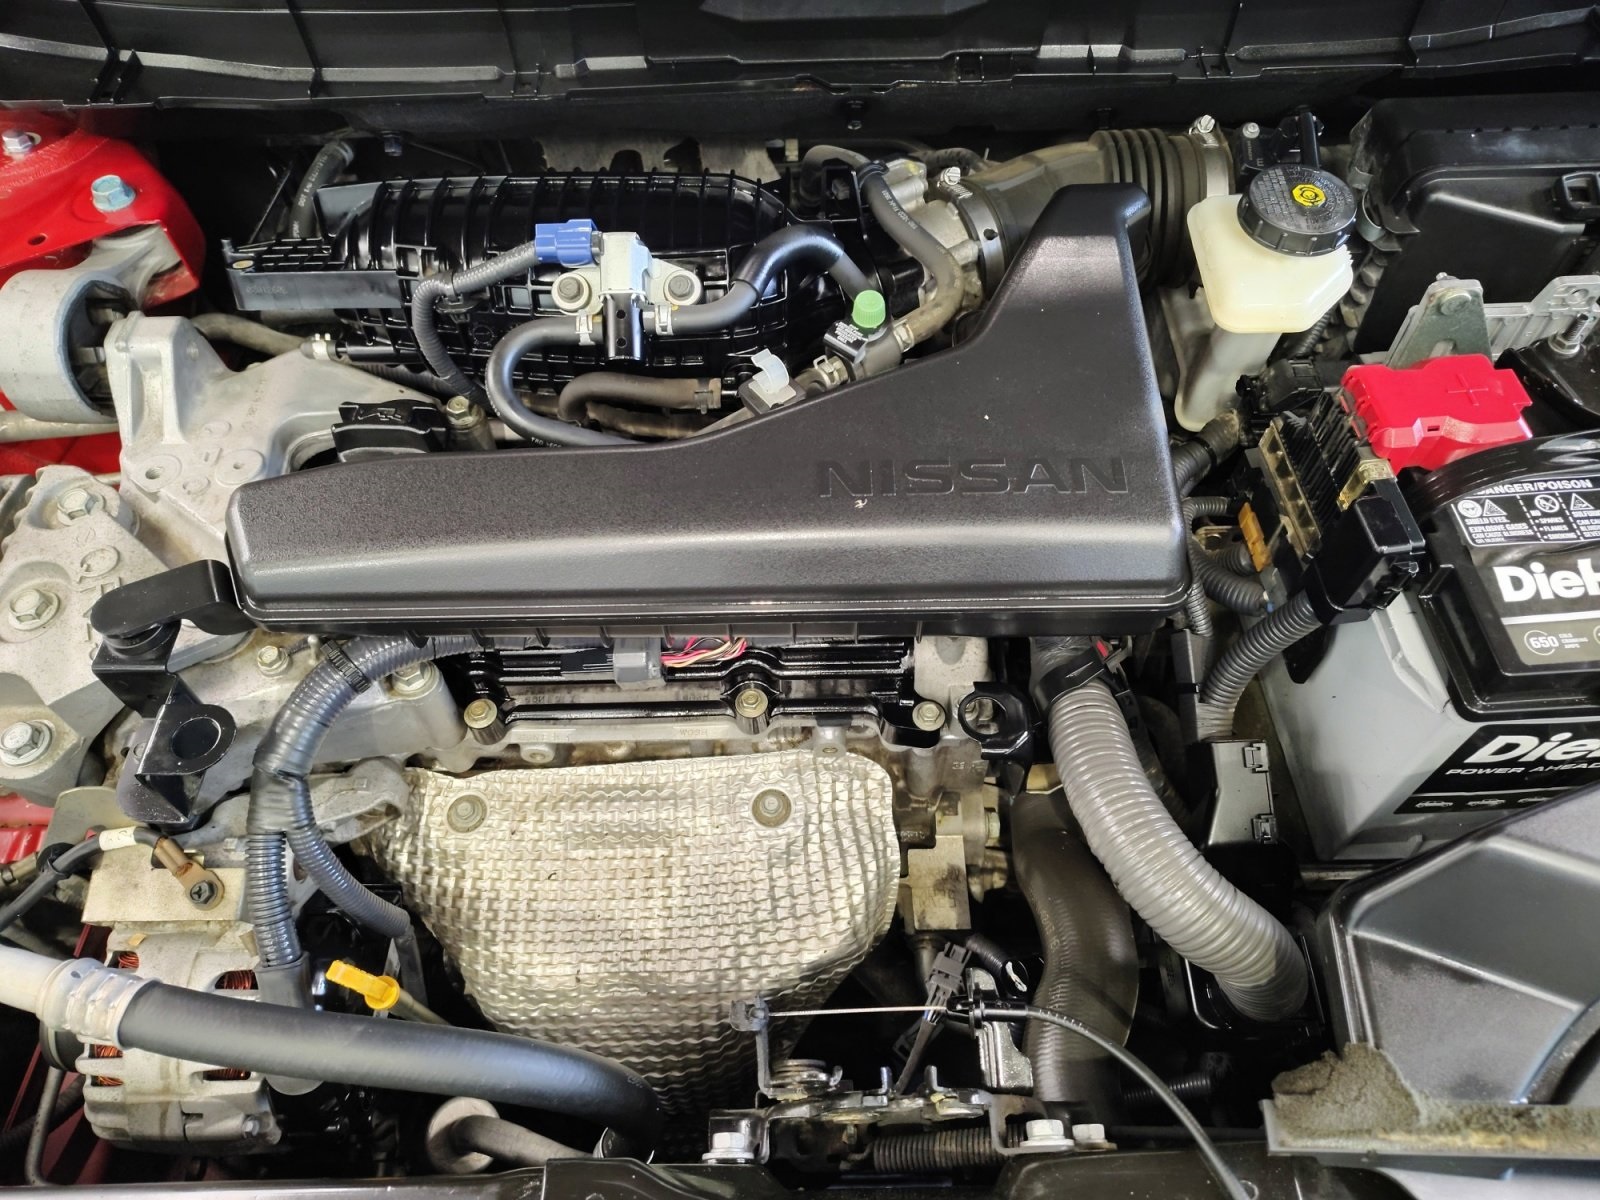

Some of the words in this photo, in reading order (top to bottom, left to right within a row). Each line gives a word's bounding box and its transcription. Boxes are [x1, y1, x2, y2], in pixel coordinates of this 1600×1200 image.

[817, 457, 1129, 498] NISSAN
[1529, 635, 1559, 649] 650
[1463, 732, 1600, 764] Die
[1445, 767, 1526, 776] POWER
[1529, 762, 1600, 773] AHEAD
